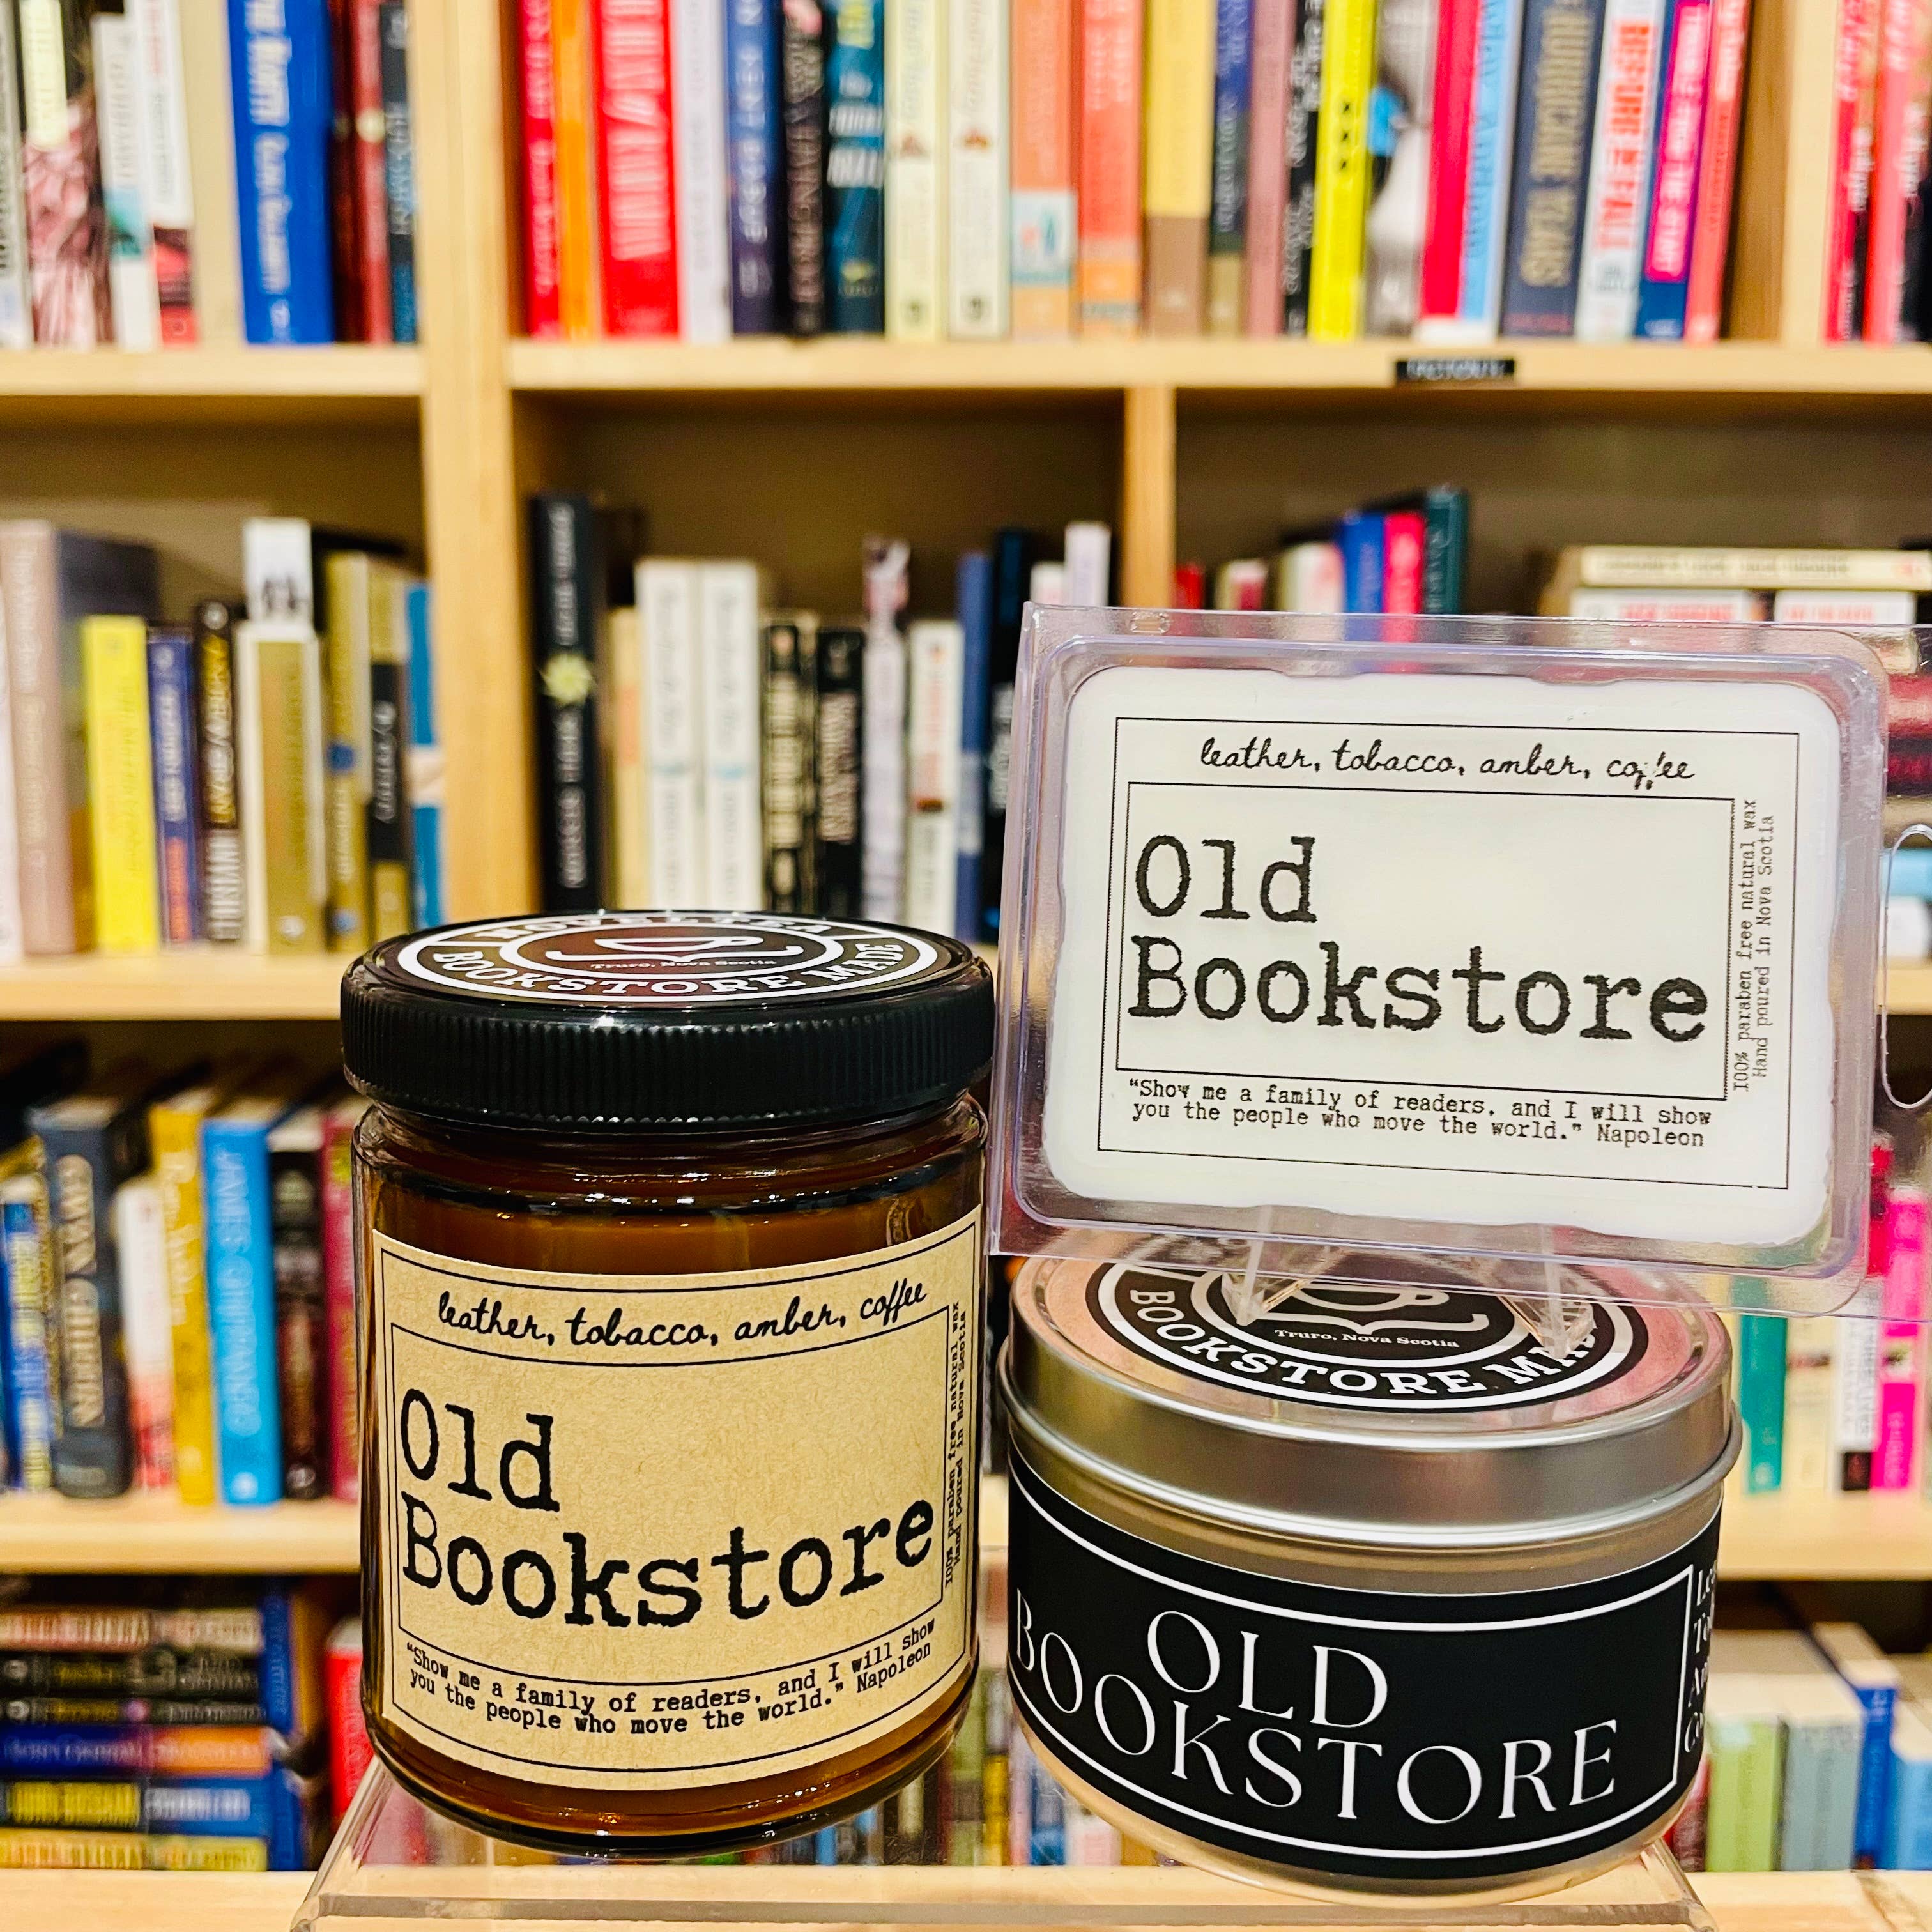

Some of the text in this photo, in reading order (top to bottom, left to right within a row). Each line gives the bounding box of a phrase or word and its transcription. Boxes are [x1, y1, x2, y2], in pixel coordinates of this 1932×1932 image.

[1201, 737, 1321, 772] leather,
[1331, 739, 1465, 776] tobacco,
[1480, 743, 1590, 779] amber,
[1135, 835, 1317, 922] Old
[432, 944, 905, 996] BOOKSTORE MADE
[1128, 935, 1707, 1042] Bookstore
[1733, 799, 1758, 1092] 100% paraben free natural wax
[1751, 815, 1774, 1077] Hand poured in Nova Scotia
[1133, 1101, 1170, 1123] you
[1184, 1103, 1220, 1121] the
[1233, 1107, 1308, 1129] people
[1321, 1110, 1359, 1128] who
[1373, 1114, 1425, 1131] move
[1439, 1116, 1478, 1135] the
[1597, 1126, 1704, 1147] Napoleon
[1202, 1084, 1227, 1100] me
[1240, 1089, 1252, 1102] a
[1265, 1085, 1342, 1111] family
[1354, 1091, 1380, 1109] of
[1512, 1099, 1551, 1119] and
[1565, 1101, 1577, 1119] I
[1591, 1102, 1641, 1123] will
[1658, 1106, 1712, 1126] show
[438, 1277, 928, 1346] leather, tobacco, amber, coffee
[1130, 1289, 1486, 1396] BOOKSTORE
[1274, 1330, 1460, 1348] Truro, Nova Scotia
[401, 1388, 560, 1512] Old
[401, 1491, 934, 1628] Bookstore
[410, 1669, 435, 1696] you
[445, 1682, 476, 1710] the
[486, 1701, 562, 1730] people
[575, 1713, 616, 1734] who
[630, 1717, 687, 1735] move
[703, 1710, 744, 1730] the
[856, 1642, 931, 1693] Napoleon
[459, 1670, 480, 1691] me
[492, 1682, 502, 1698] a
[516, 1683, 595, 1716] family
[609, 1692, 636, 1712] of
[652, 1688, 761, 1712] readers,
[778, 1669, 816, 1696] and
[827, 1662, 839, 1683] I
[851, 1642, 893, 1674] will
[902, 1618, 935, 1652] show
[1016, 1588, 1618, 1825] BOOKSTORE
[1147, 1610, 1388, 1729] OLD
